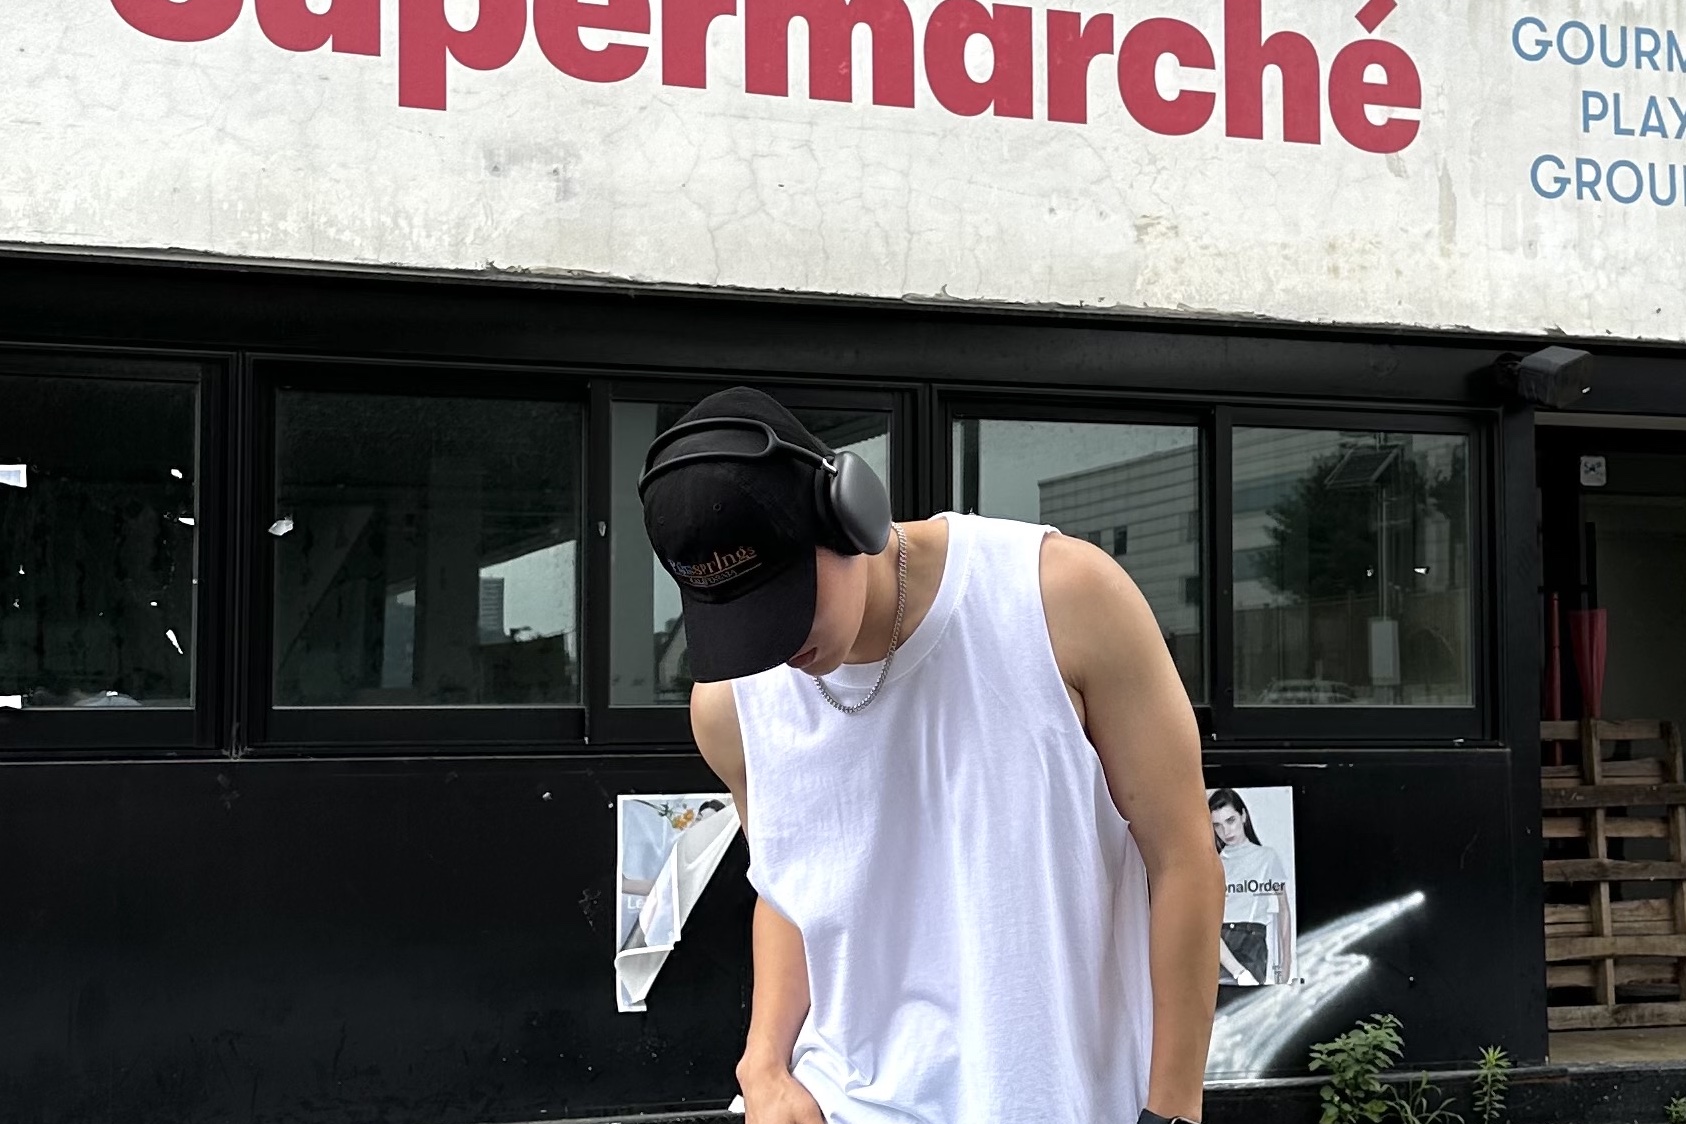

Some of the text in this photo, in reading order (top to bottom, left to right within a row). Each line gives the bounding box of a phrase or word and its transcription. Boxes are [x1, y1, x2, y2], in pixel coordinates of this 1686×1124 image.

[112, 0, 1421, 153] permarché
[1530, 154, 1686, 206] GROU
[1225, 878, 1286, 894] nalOrder
